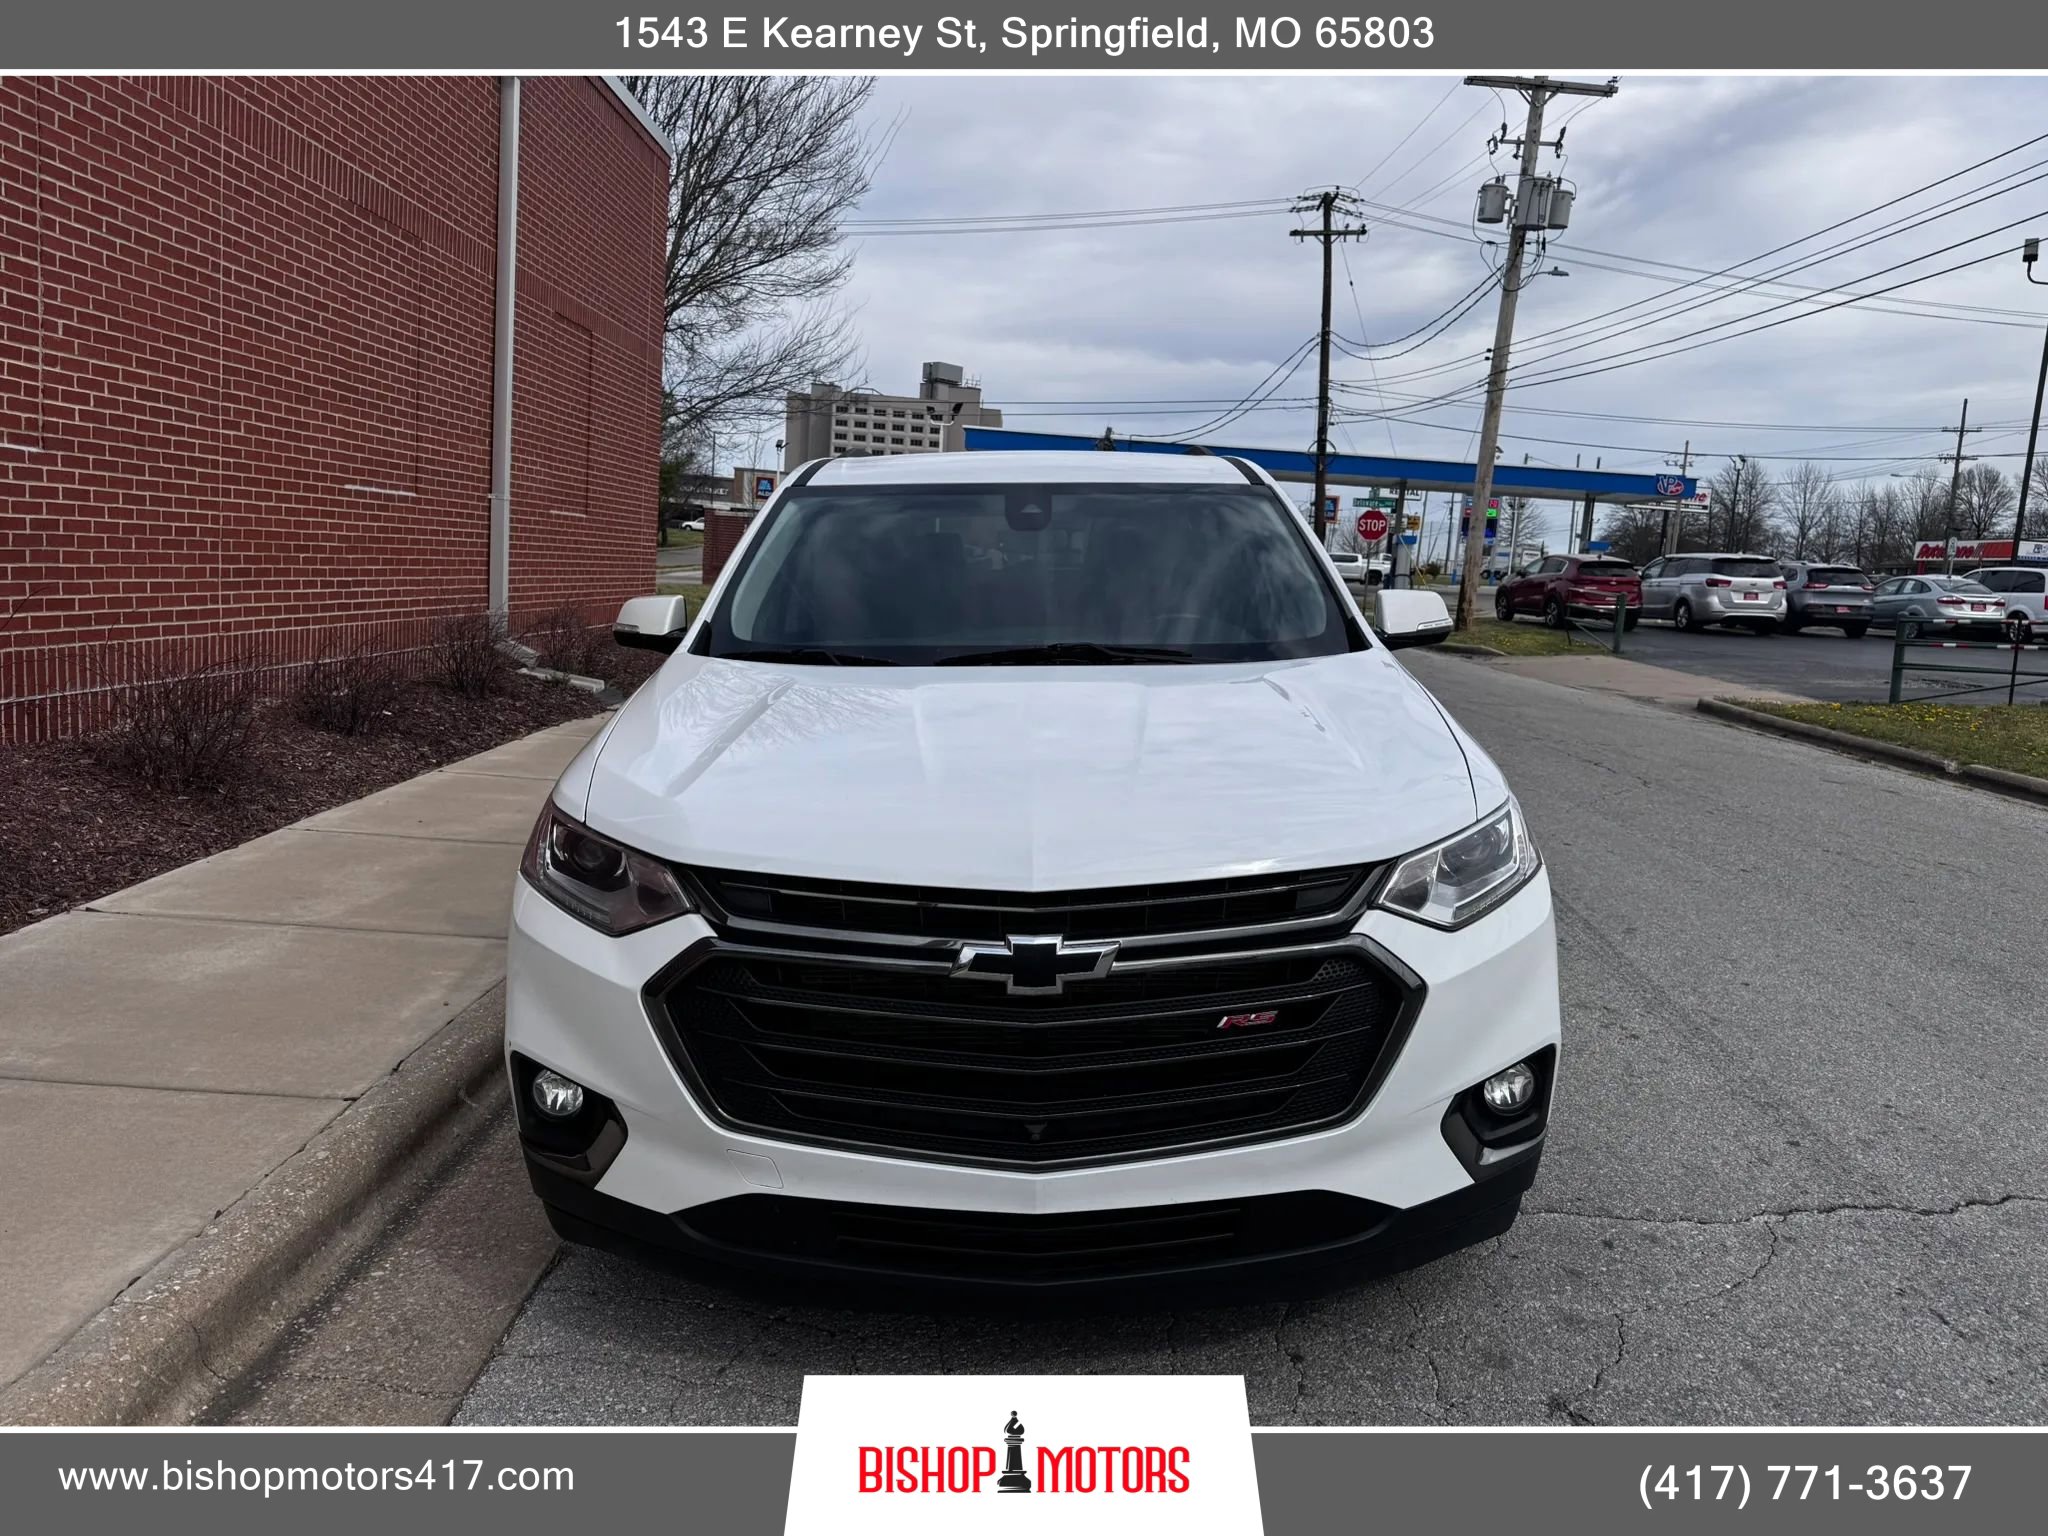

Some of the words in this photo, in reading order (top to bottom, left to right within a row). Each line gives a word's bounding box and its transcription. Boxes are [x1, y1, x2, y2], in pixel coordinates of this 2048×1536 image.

[1659, 475, 1678, 494] VP
[1359, 519, 1386, 532] STOP
[1216, 1010, 1279, 1031] RS
